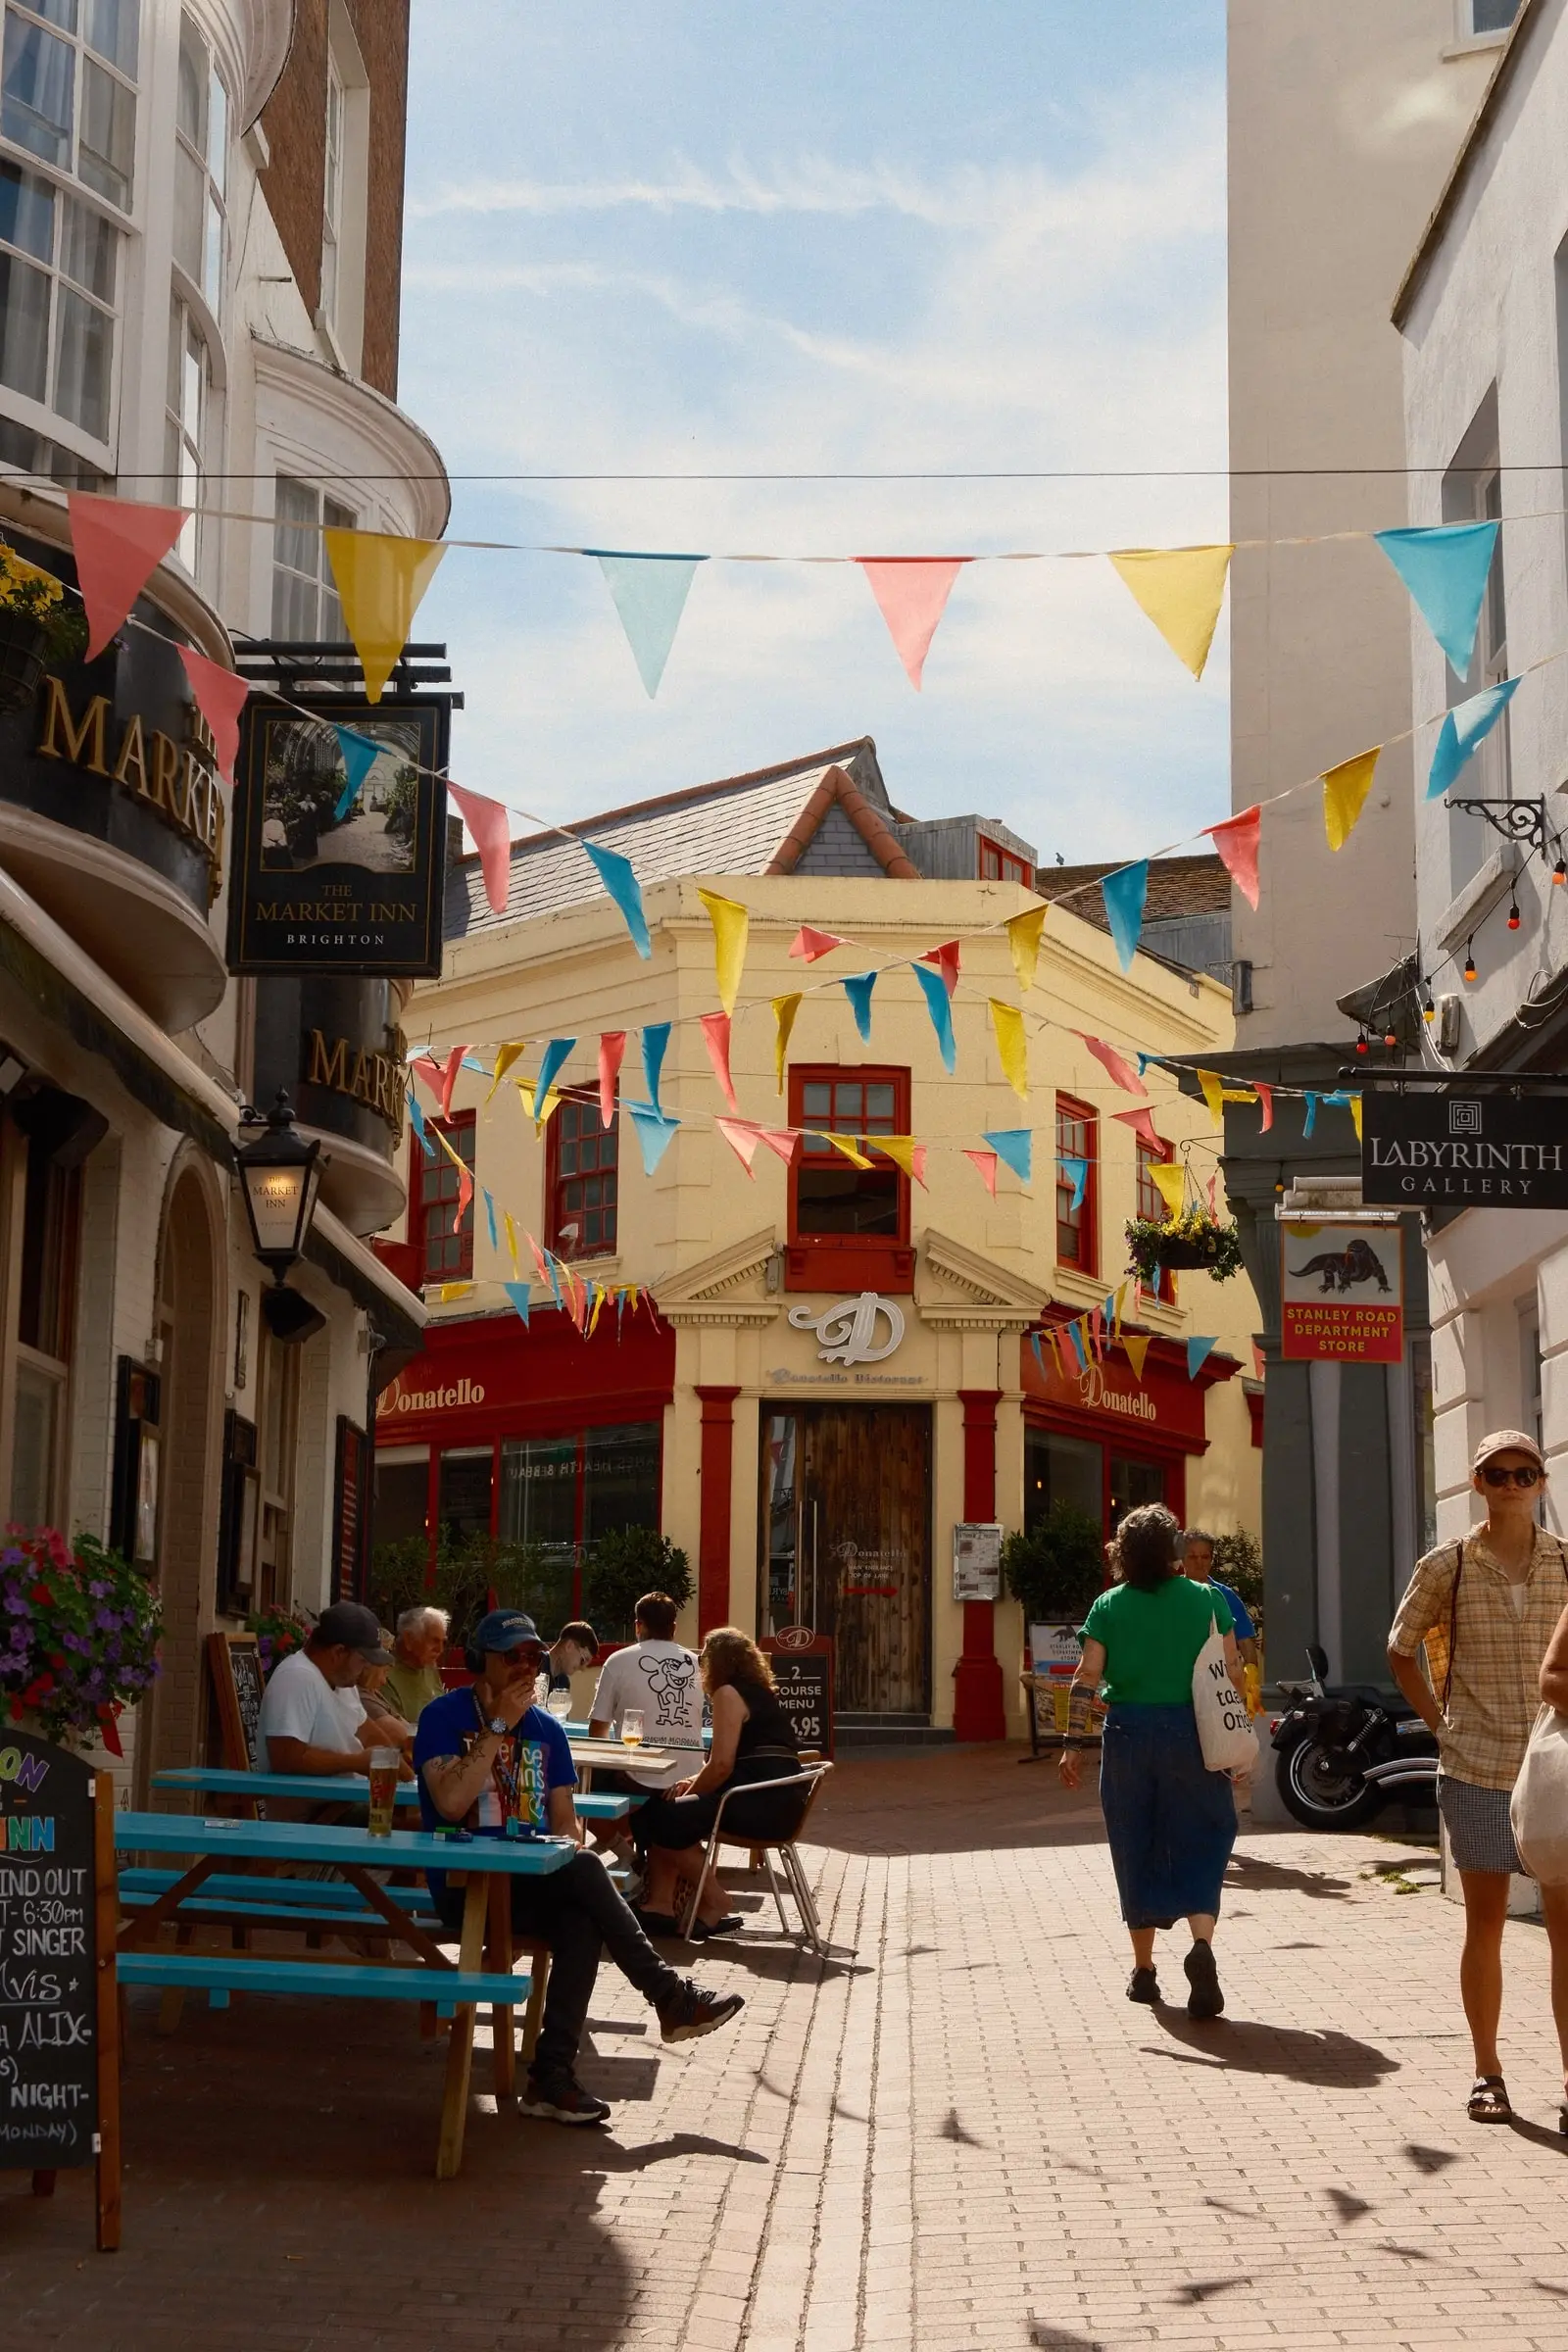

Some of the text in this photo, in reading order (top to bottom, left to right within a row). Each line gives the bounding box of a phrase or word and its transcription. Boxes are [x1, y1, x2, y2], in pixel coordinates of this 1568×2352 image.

[321, 884, 353, 897] THE
[255, 902, 418, 922] MARKET INN
[286, 934, 385, 945] BRIGHTON
[1369, 1137, 1563, 1171] LABYRINTH
[253, 1186, 299, 1196] MARKET
[1400, 1176, 1533, 1196] GALLERY
[266, 1199, 286, 1208] INN
[1287, 1308, 1396, 1322] STANLEY ROAD
[1295, 1324, 1390, 1338] DEPARTMENT
[1319, 1340, 1365, 1352] STORE
[1072, 1363, 1156, 1421] Donatello
[791, 1665, 801, 1680] 2
[776, 1686, 822, 1695] OURSE
[778, 1699, 815, 1709] MENU
[44, 1868, 87, 1896] OUT
[12, 1927, 86, 1956] SINGER
